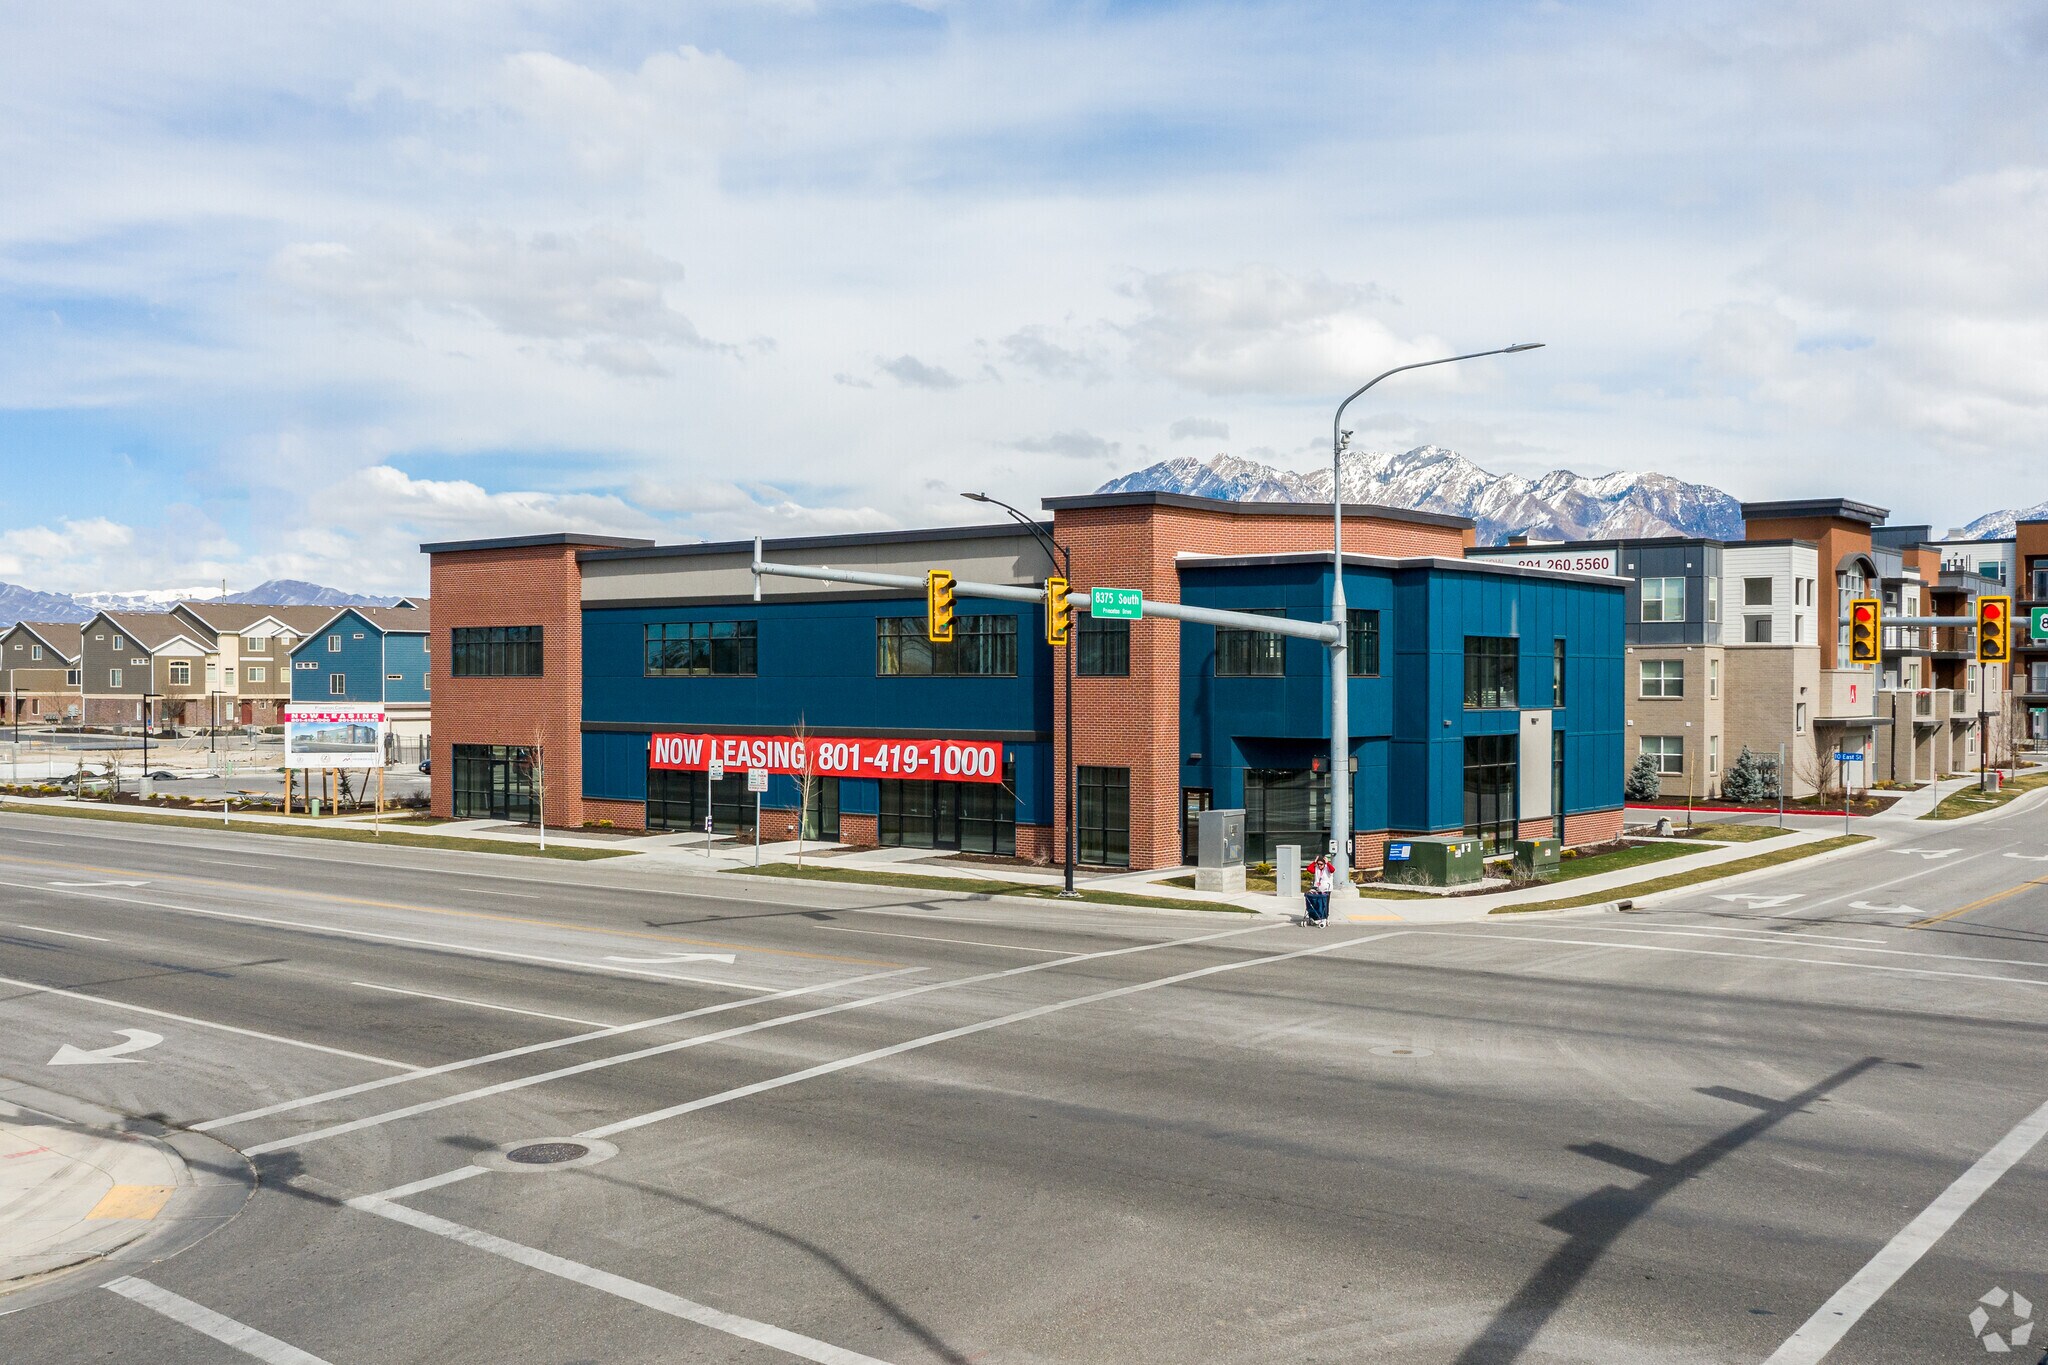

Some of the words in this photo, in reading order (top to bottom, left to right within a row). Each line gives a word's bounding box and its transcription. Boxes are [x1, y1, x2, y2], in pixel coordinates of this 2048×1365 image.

[1095, 591, 1114, 604] 8375
[1118, 592, 1139, 605] South
[655, 737, 703, 765] NOW
[711, 739, 805, 769] LEASING
[818, 742, 996, 777] 801-419-1000
